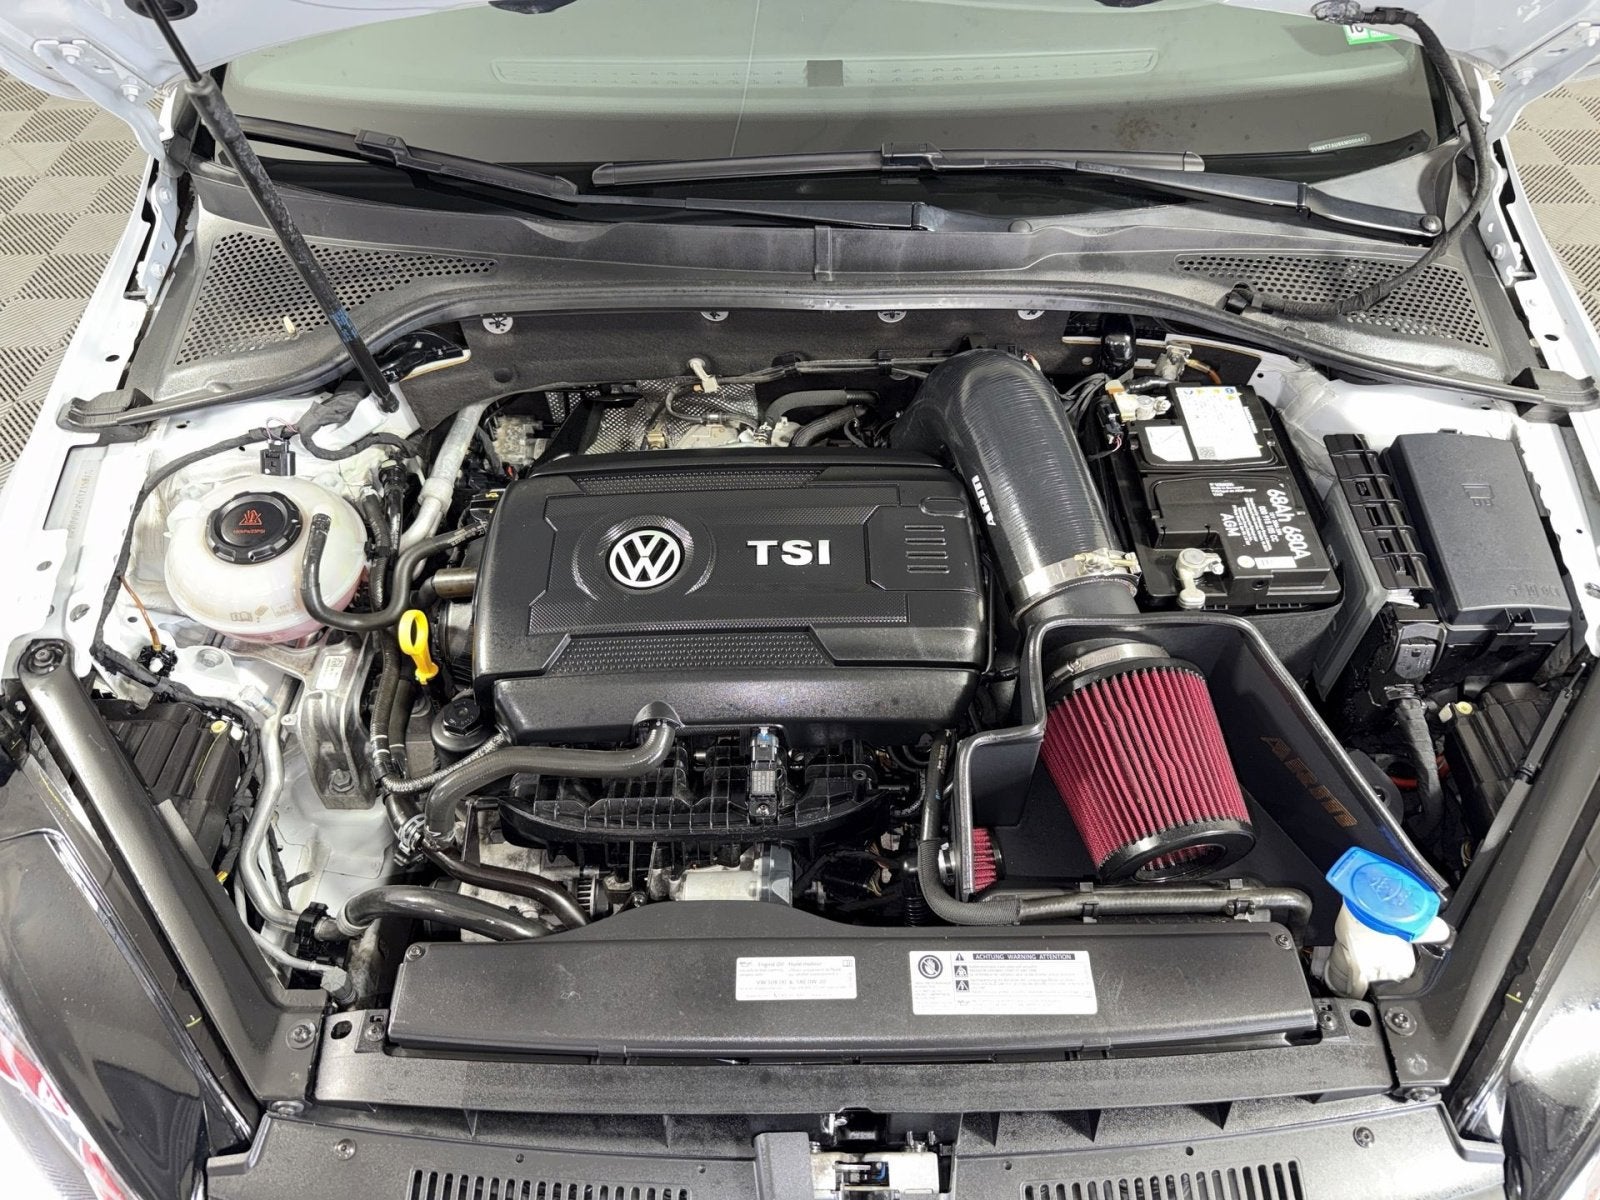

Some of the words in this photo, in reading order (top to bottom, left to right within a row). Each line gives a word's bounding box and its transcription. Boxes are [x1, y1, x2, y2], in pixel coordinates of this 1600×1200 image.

[1220, 513, 1242, 537] AGM
[1266, 488, 1295, 522] 68Ah
[1282, 525, 1312, 560] 680A
[746, 539, 831, 566] TSI
